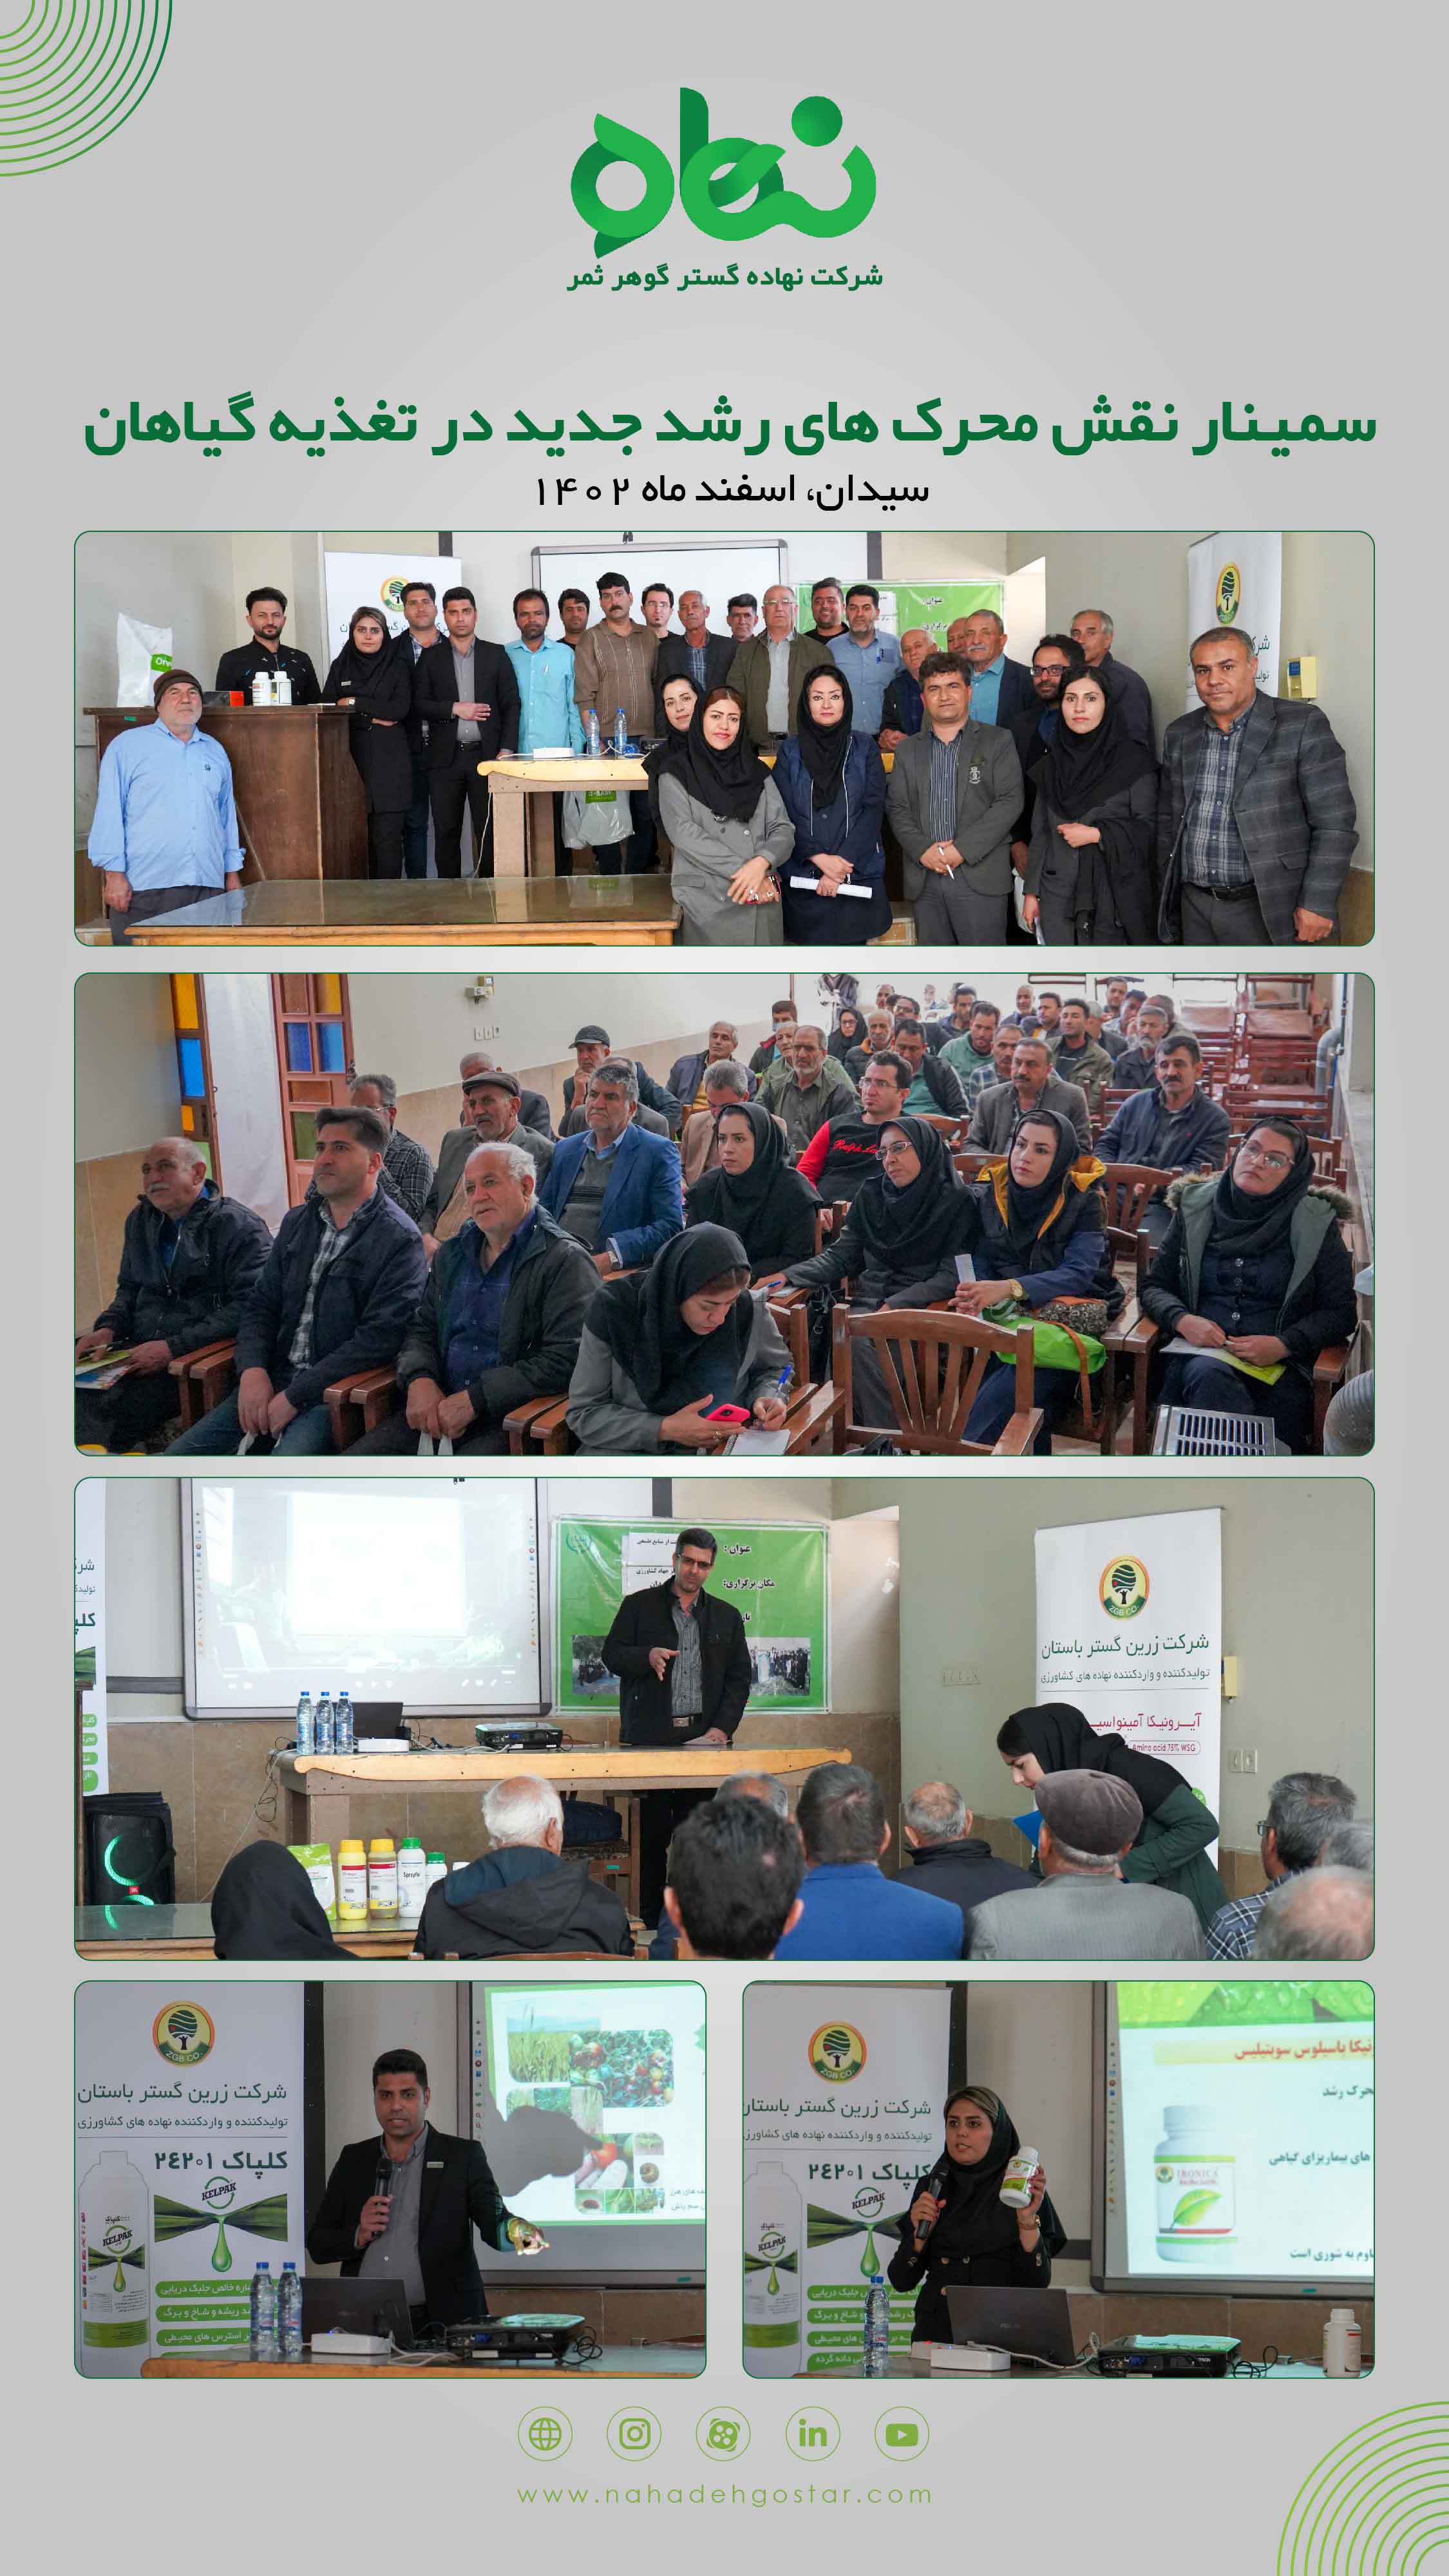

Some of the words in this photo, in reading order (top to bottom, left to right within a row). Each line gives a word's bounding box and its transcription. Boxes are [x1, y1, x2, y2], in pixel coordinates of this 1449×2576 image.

[730, 1544, 750, 1555] عنوان
[758, 1579, 775, 1589] مکان
[1110, 1605, 1124, 1616] ZGB
[1042, 1640, 1083, 1659] باستان
[1087, 1636, 1121, 1657] گستر
[1127, 1635, 1159, 1656] زرین
[1163, 1634, 1209, 1654] شرکت
[1041, 1671, 1074, 1683] کشاورزی
[1076, 1672, 1091, 1683] های
[1093, 1672, 1112, 1682] نهاده
[1113, 1669, 1154, 1681] واردکننده
[1163, 1668, 1210, 1680] تولیدکننده
[1088, 1714, 1144, 1731] آمینواسی
[166, 2050, 185, 2062] ZGB
[820, 2069, 837, 2079] ZGB
[78, 2083, 133, 2103] باستان
[139, 2081, 182, 2103] گستر
[188, 2084, 228, 2104] زرین
[234, 2083, 287, 2103] شرکت
[1323, 2086, 1343, 2099] رشد
[795, 2097, 835, 2116] گستر
[841, 2099, 878, 2118] زرین
[884, 2100, 931, 2119] شرکت
[78, 2117, 124, 2129] کشاورزی
[126, 2117, 145, 2129] های
[148, 2117, 172, 2129] نهاده
[175, 2117, 223, 2130] واردکننده
[234, 2117, 288, 2130] تولیدکننده
[744, 2129, 780, 2140] کشاورز
[782, 2129, 799, 2141] های
[802, 2130, 825, 2142] نهاده
[828, 2130, 873, 2142] واردکننده
[885, 2130, 933, 2143] تولیدکننده
[1350, 2151, 1371, 2164] های
[222, 2151, 288, 2179] کلپاک
[202, 2182, 236, 2201] KELPAK
[852, 2192, 886, 2210] KELPAK
[102, 2230, 133, 2246] KELPAK
[757, 2236, 786, 2251] KELPAK
[164, 2307, 182, 2318] برگ
[191, 2307, 210, 2320] شاخ
[218, 2307, 240, 2316] ریشه
[840, 2311, 858, 2322] شاخ
[194, 2333, 209, 2342] های
[842, 2334, 857, 2344] های
